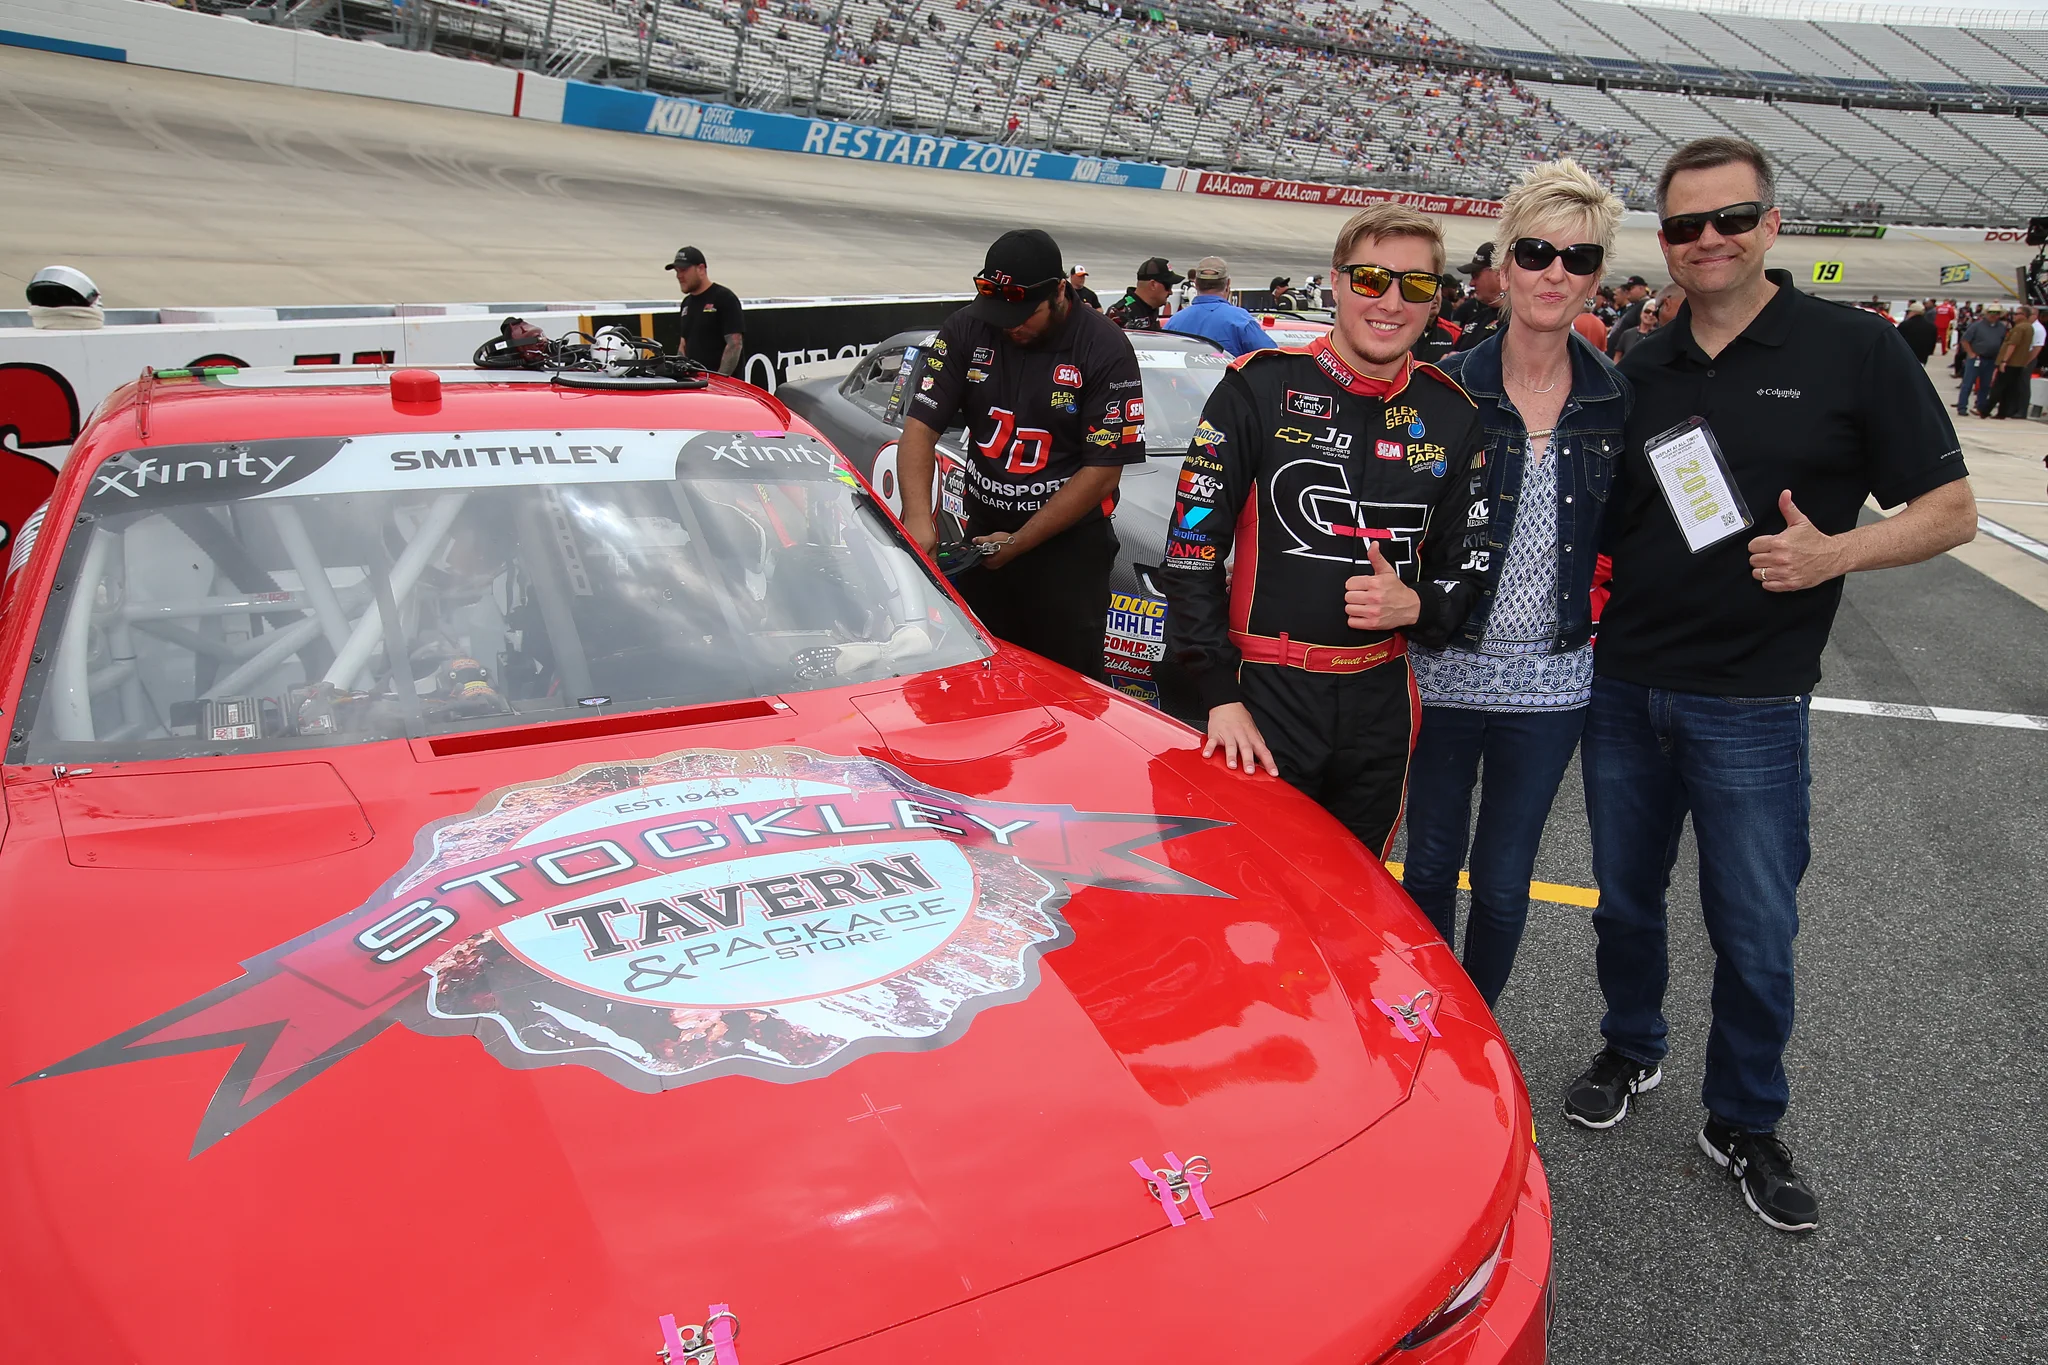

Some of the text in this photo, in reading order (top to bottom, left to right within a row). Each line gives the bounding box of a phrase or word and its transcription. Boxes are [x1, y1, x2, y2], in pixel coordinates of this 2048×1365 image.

[703, 106, 735, 125] OFFICE
[698, 123, 754, 145] TECHNOLOGY
[802, 121, 1041, 177] RESTART ZONE
[1203, 174, 1254, 196] AAA.com
[1274, 182, 1321, 202] AAA.com
[1404, 194, 1448, 213] AAA.com
[1467, 203, 1502, 218] AAA.co
[1816, 264, 1840, 281] 19
[1058, 368, 1079, 384] SEM
[1051, 391, 1074, 400] FLEX
[1766, 388, 1801, 396] Columbia
[1051, 397, 1074, 407] SEAL
[1294, 399, 1324, 413] xfinity
[1385, 405, 1419, 420] FLEX
[1386, 415, 1418, 430] SEAL
[1086, 432, 1121, 442] SUNOCO
[704, 439, 836, 473] xfinity
[1311, 443, 1351, 455] MOTORSPORTS
[1377, 442, 1401, 458] SEM
[1406, 443, 1445, 456] FLEX
[1656, 448, 1672, 459] DISPLAY
[390, 445, 624, 472] SMITHLEY
[1406, 452, 1445, 467] TAPE
[93, 452, 296, 498] xfinity
[981, 494, 1013, 511] GARY
[1104, 635, 1147, 655] COMP
[1129, 651, 1155, 660] CAMS
[1331, 656, 1362, 667] Garrett
[1103, 656, 1152, 677] Edelbrock
[614, 787, 740, 814] EST. 1948
[353, 798, 1041, 965] STOCKLEY
[545, 853, 942, 962] TAVERN
[623, 896, 956, 993] & PACKAGE
[775, 928, 893, 961] STORE
